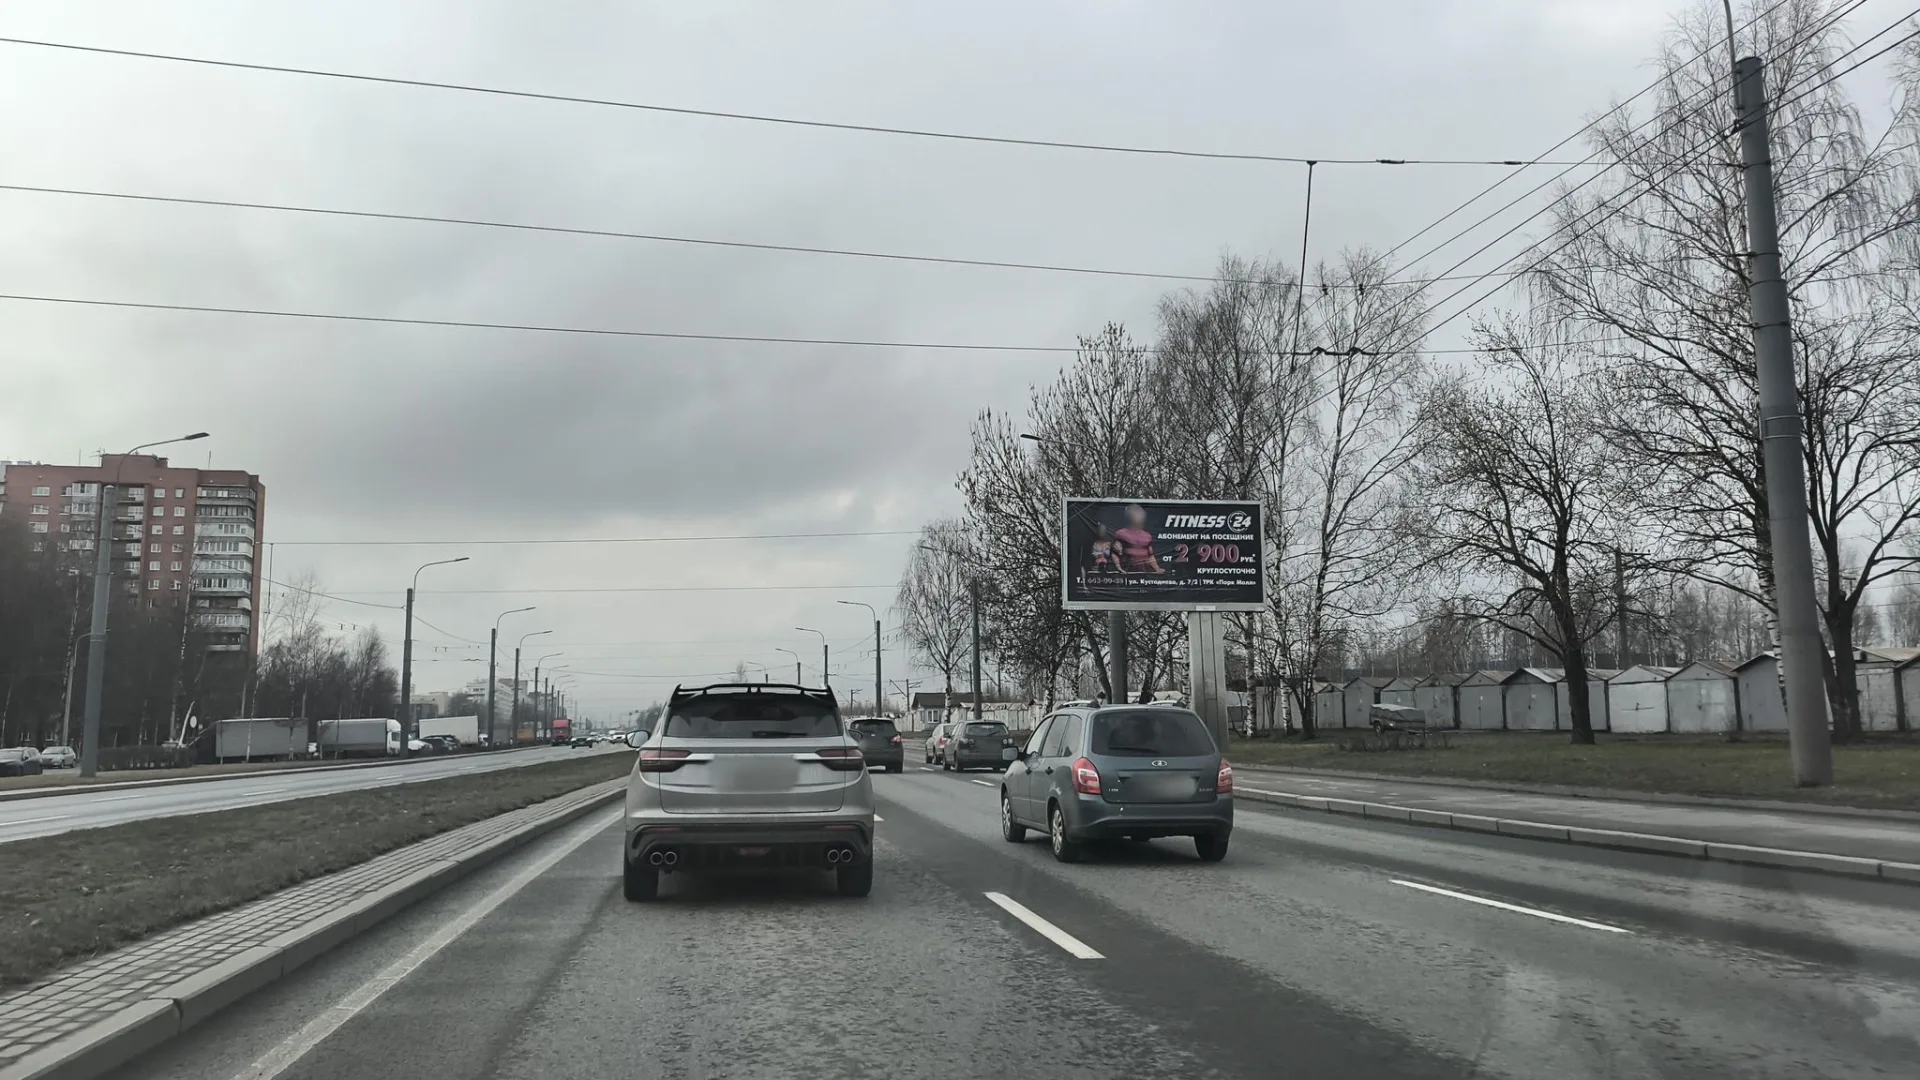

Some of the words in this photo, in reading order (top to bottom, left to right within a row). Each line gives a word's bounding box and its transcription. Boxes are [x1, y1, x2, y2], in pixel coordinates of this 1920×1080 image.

[1165, 514, 1227, 528] FITNESS
[1232, 516, 1252, 528] 24
[1175, 543, 1189, 563] 2
[1197, 543, 1240, 564] 900
[1197, 567, 1256, 575] КРУГЛОСУТОЧНО
